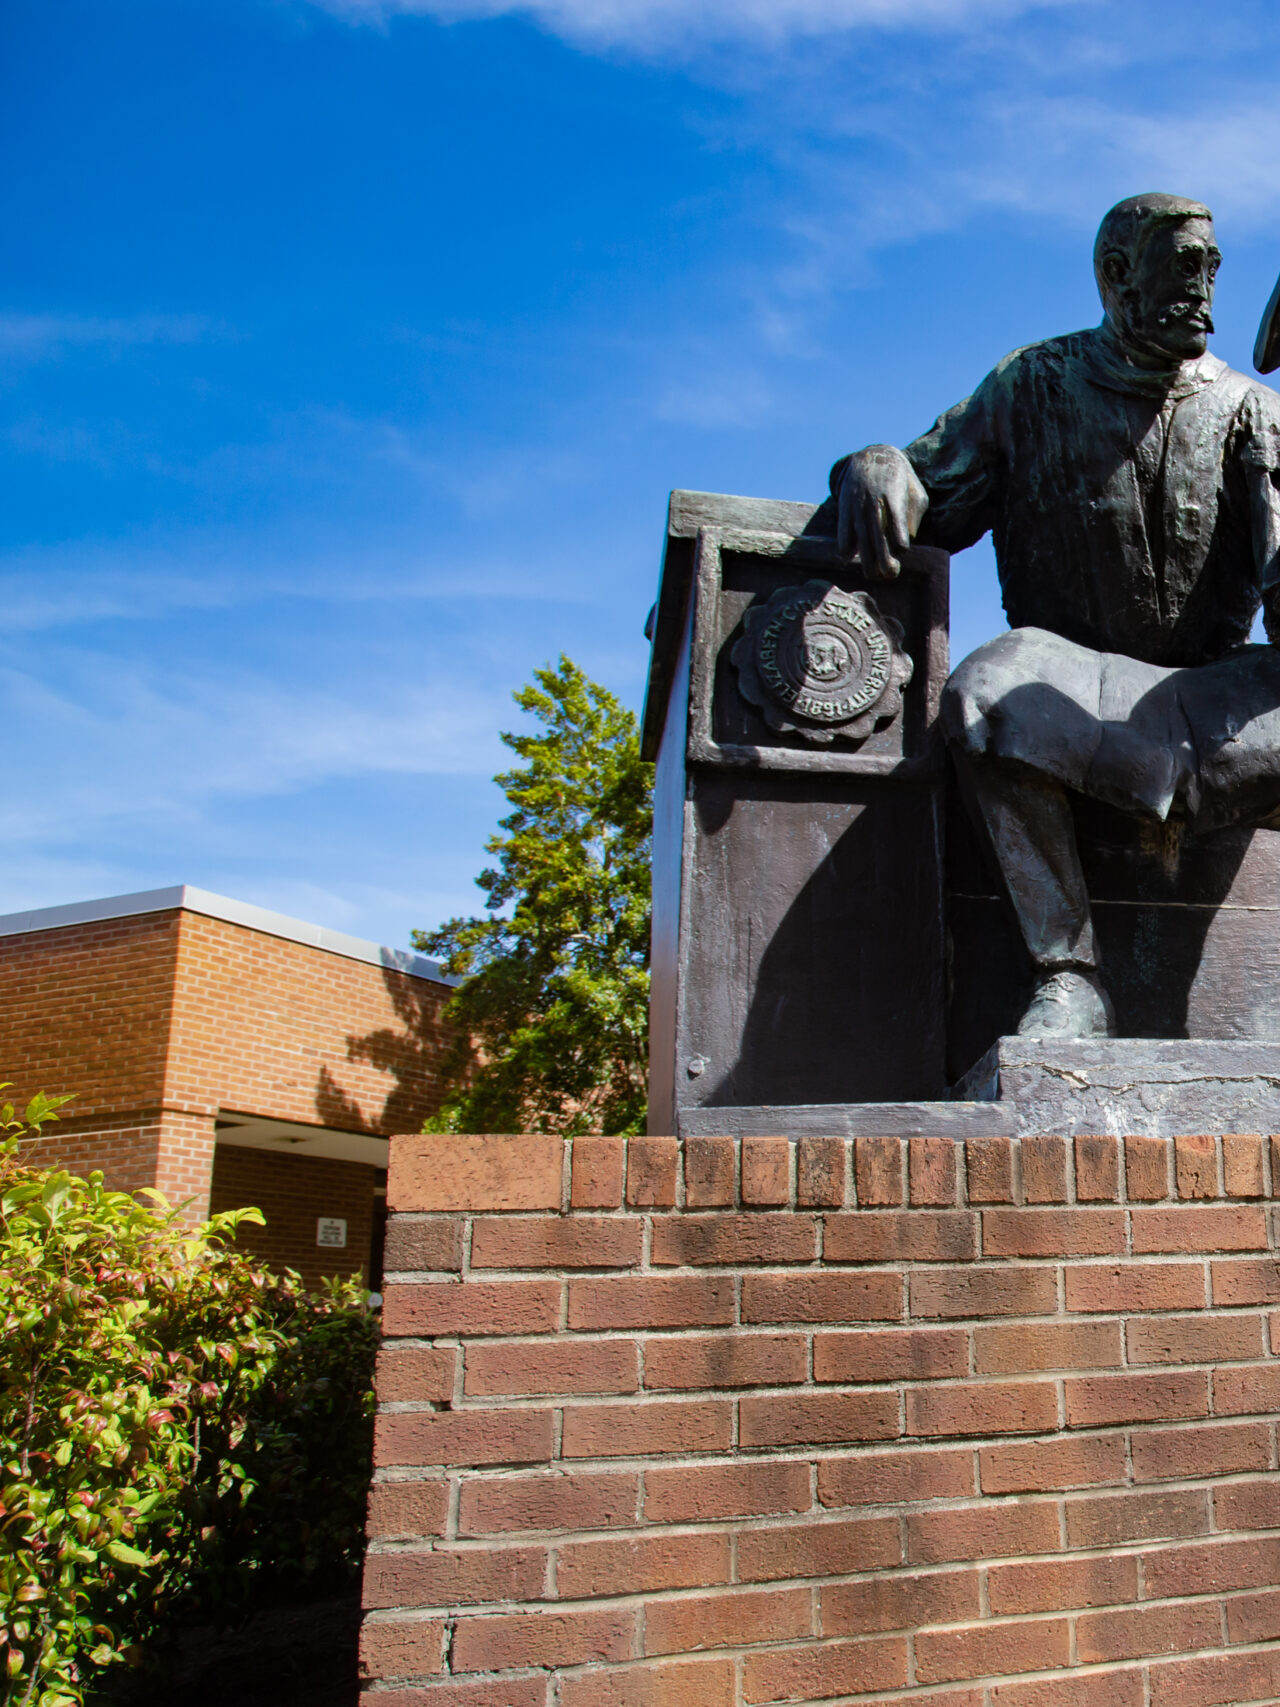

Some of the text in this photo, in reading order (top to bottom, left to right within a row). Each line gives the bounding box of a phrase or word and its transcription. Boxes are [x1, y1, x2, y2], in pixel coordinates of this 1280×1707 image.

[823, 601, 871, 632] STATE
[847, 631, 889, 711] UNIVERSITY
[803, 698, 844, 717] 1891
